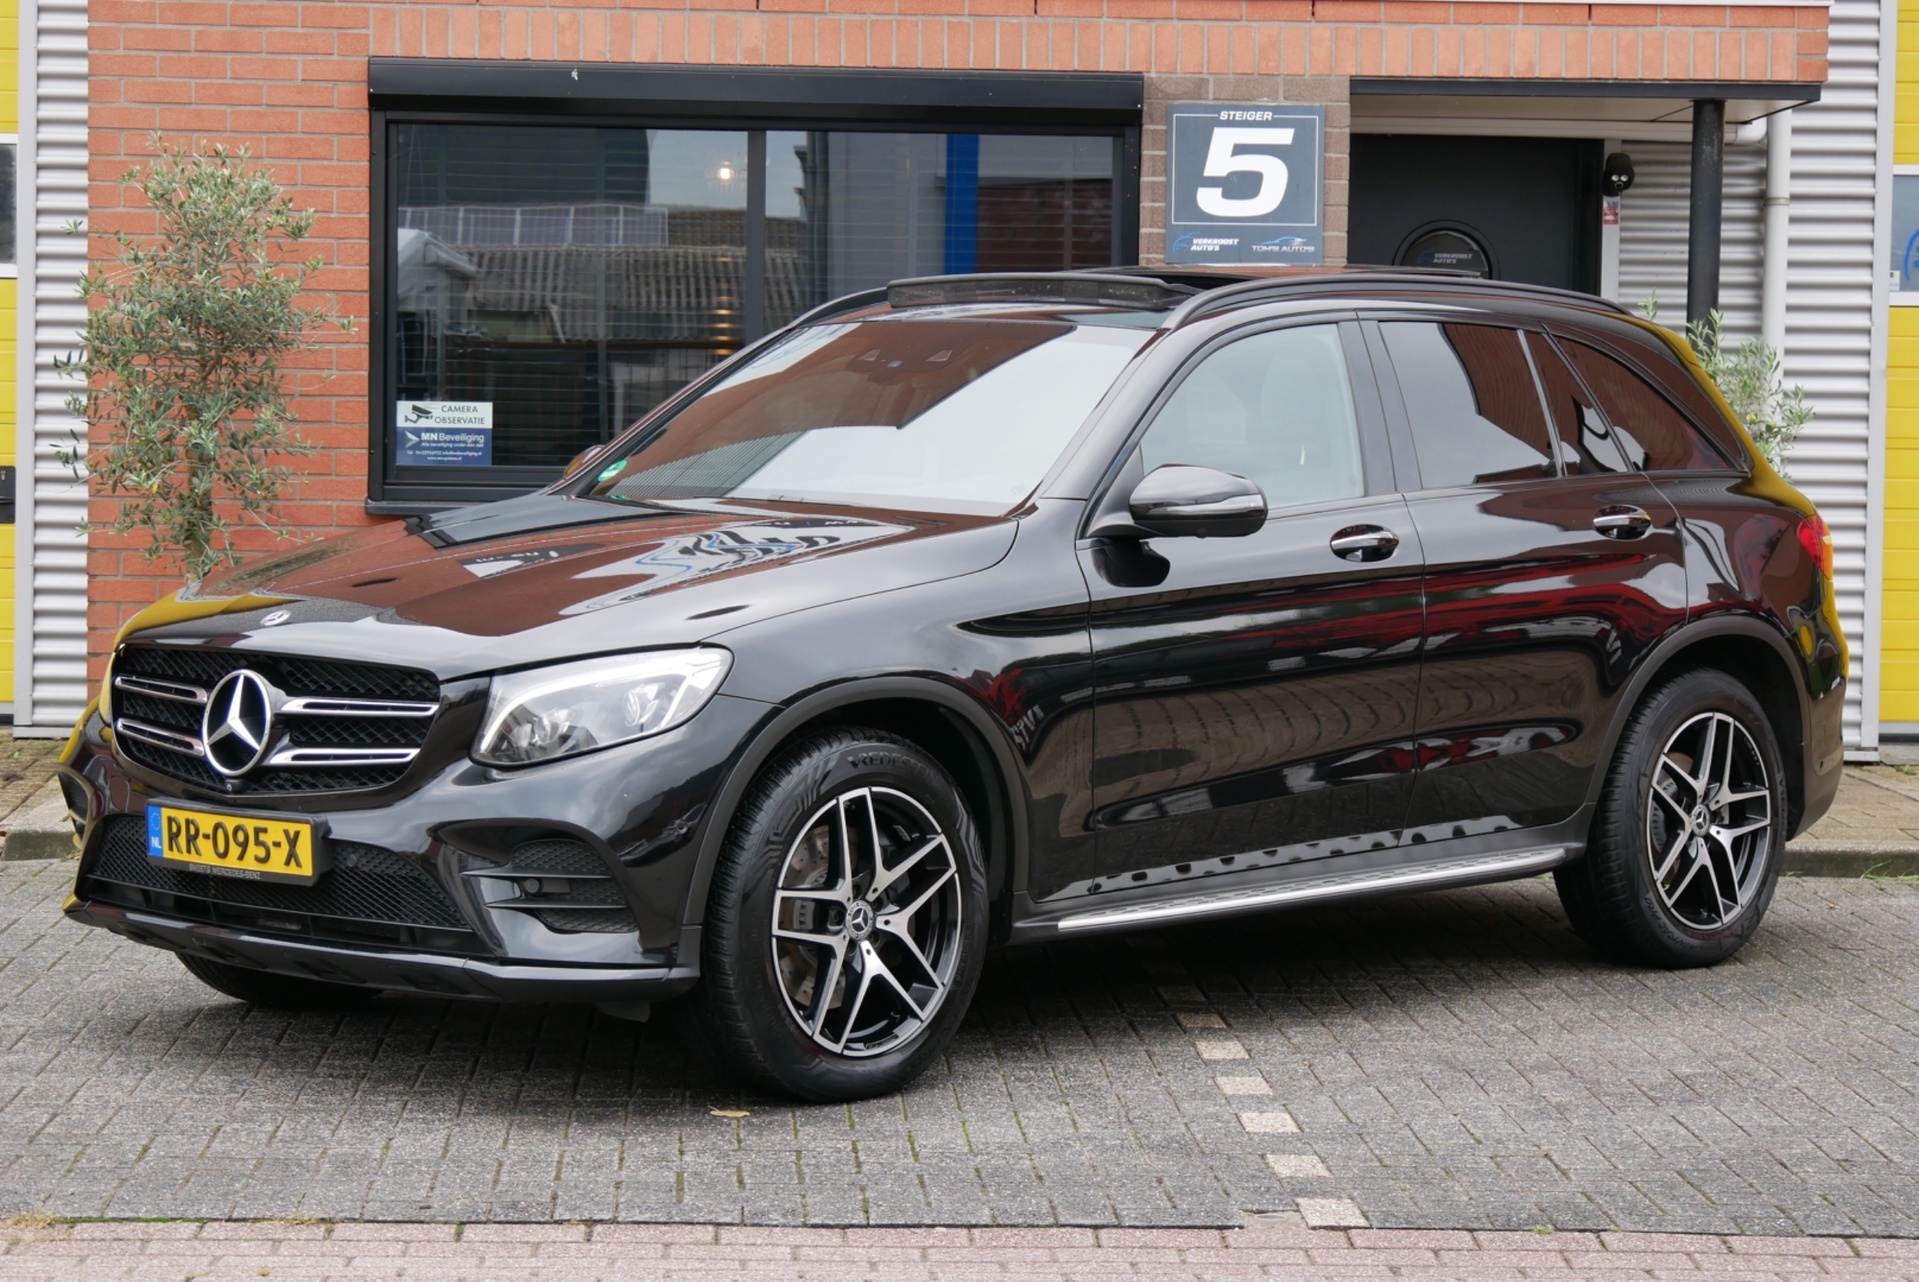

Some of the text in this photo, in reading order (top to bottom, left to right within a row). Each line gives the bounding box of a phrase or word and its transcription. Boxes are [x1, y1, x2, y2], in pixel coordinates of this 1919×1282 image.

[1219, 111, 1273, 121] STEIGER
[1196, 126, 1295, 218] 5
[441, 405, 478, 413] CAMERA
[434, 416, 485, 425] OBSERVATIE
[421, 432, 485, 443] MN Beveiliging
[151, 836, 162, 849] NL
[167, 816, 303, 868] RR-095-X
